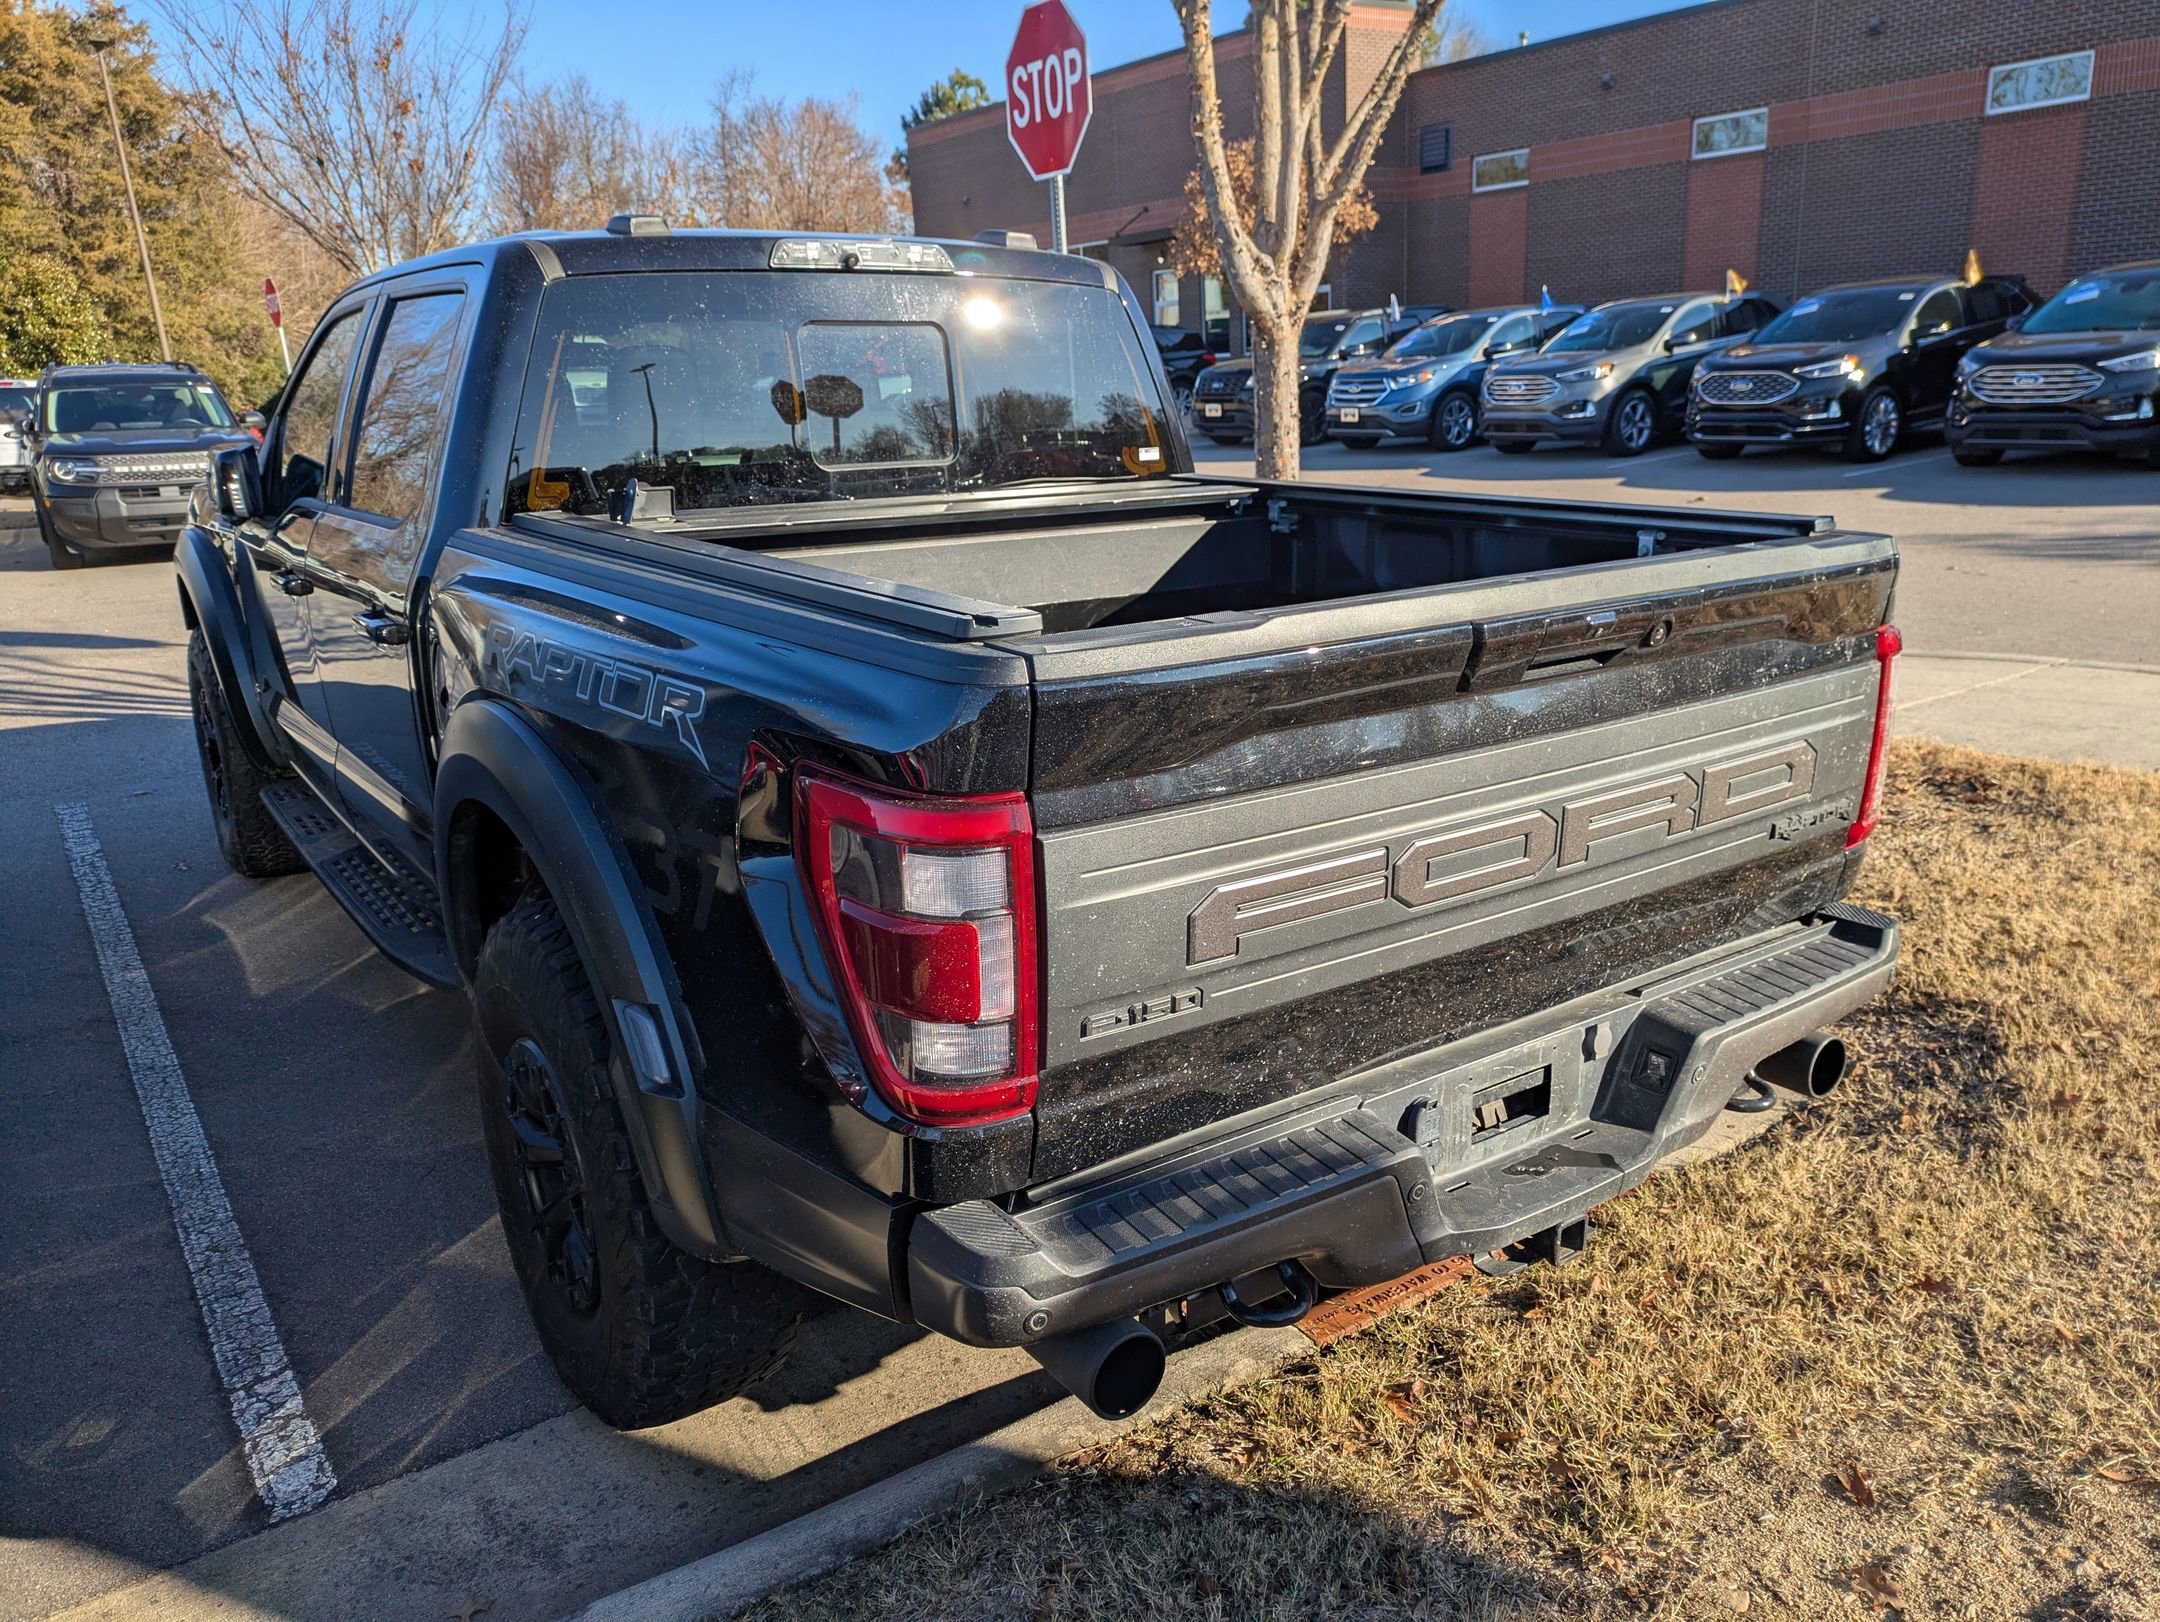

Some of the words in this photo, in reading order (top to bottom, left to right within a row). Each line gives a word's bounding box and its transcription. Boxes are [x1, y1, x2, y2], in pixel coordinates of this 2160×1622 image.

[1012, 47, 1082, 129] STOP
[485, 620, 710, 772] RAPTOR
[1186, 739, 1818, 967] FORD
[1080, 986, 1204, 1043] F-150
